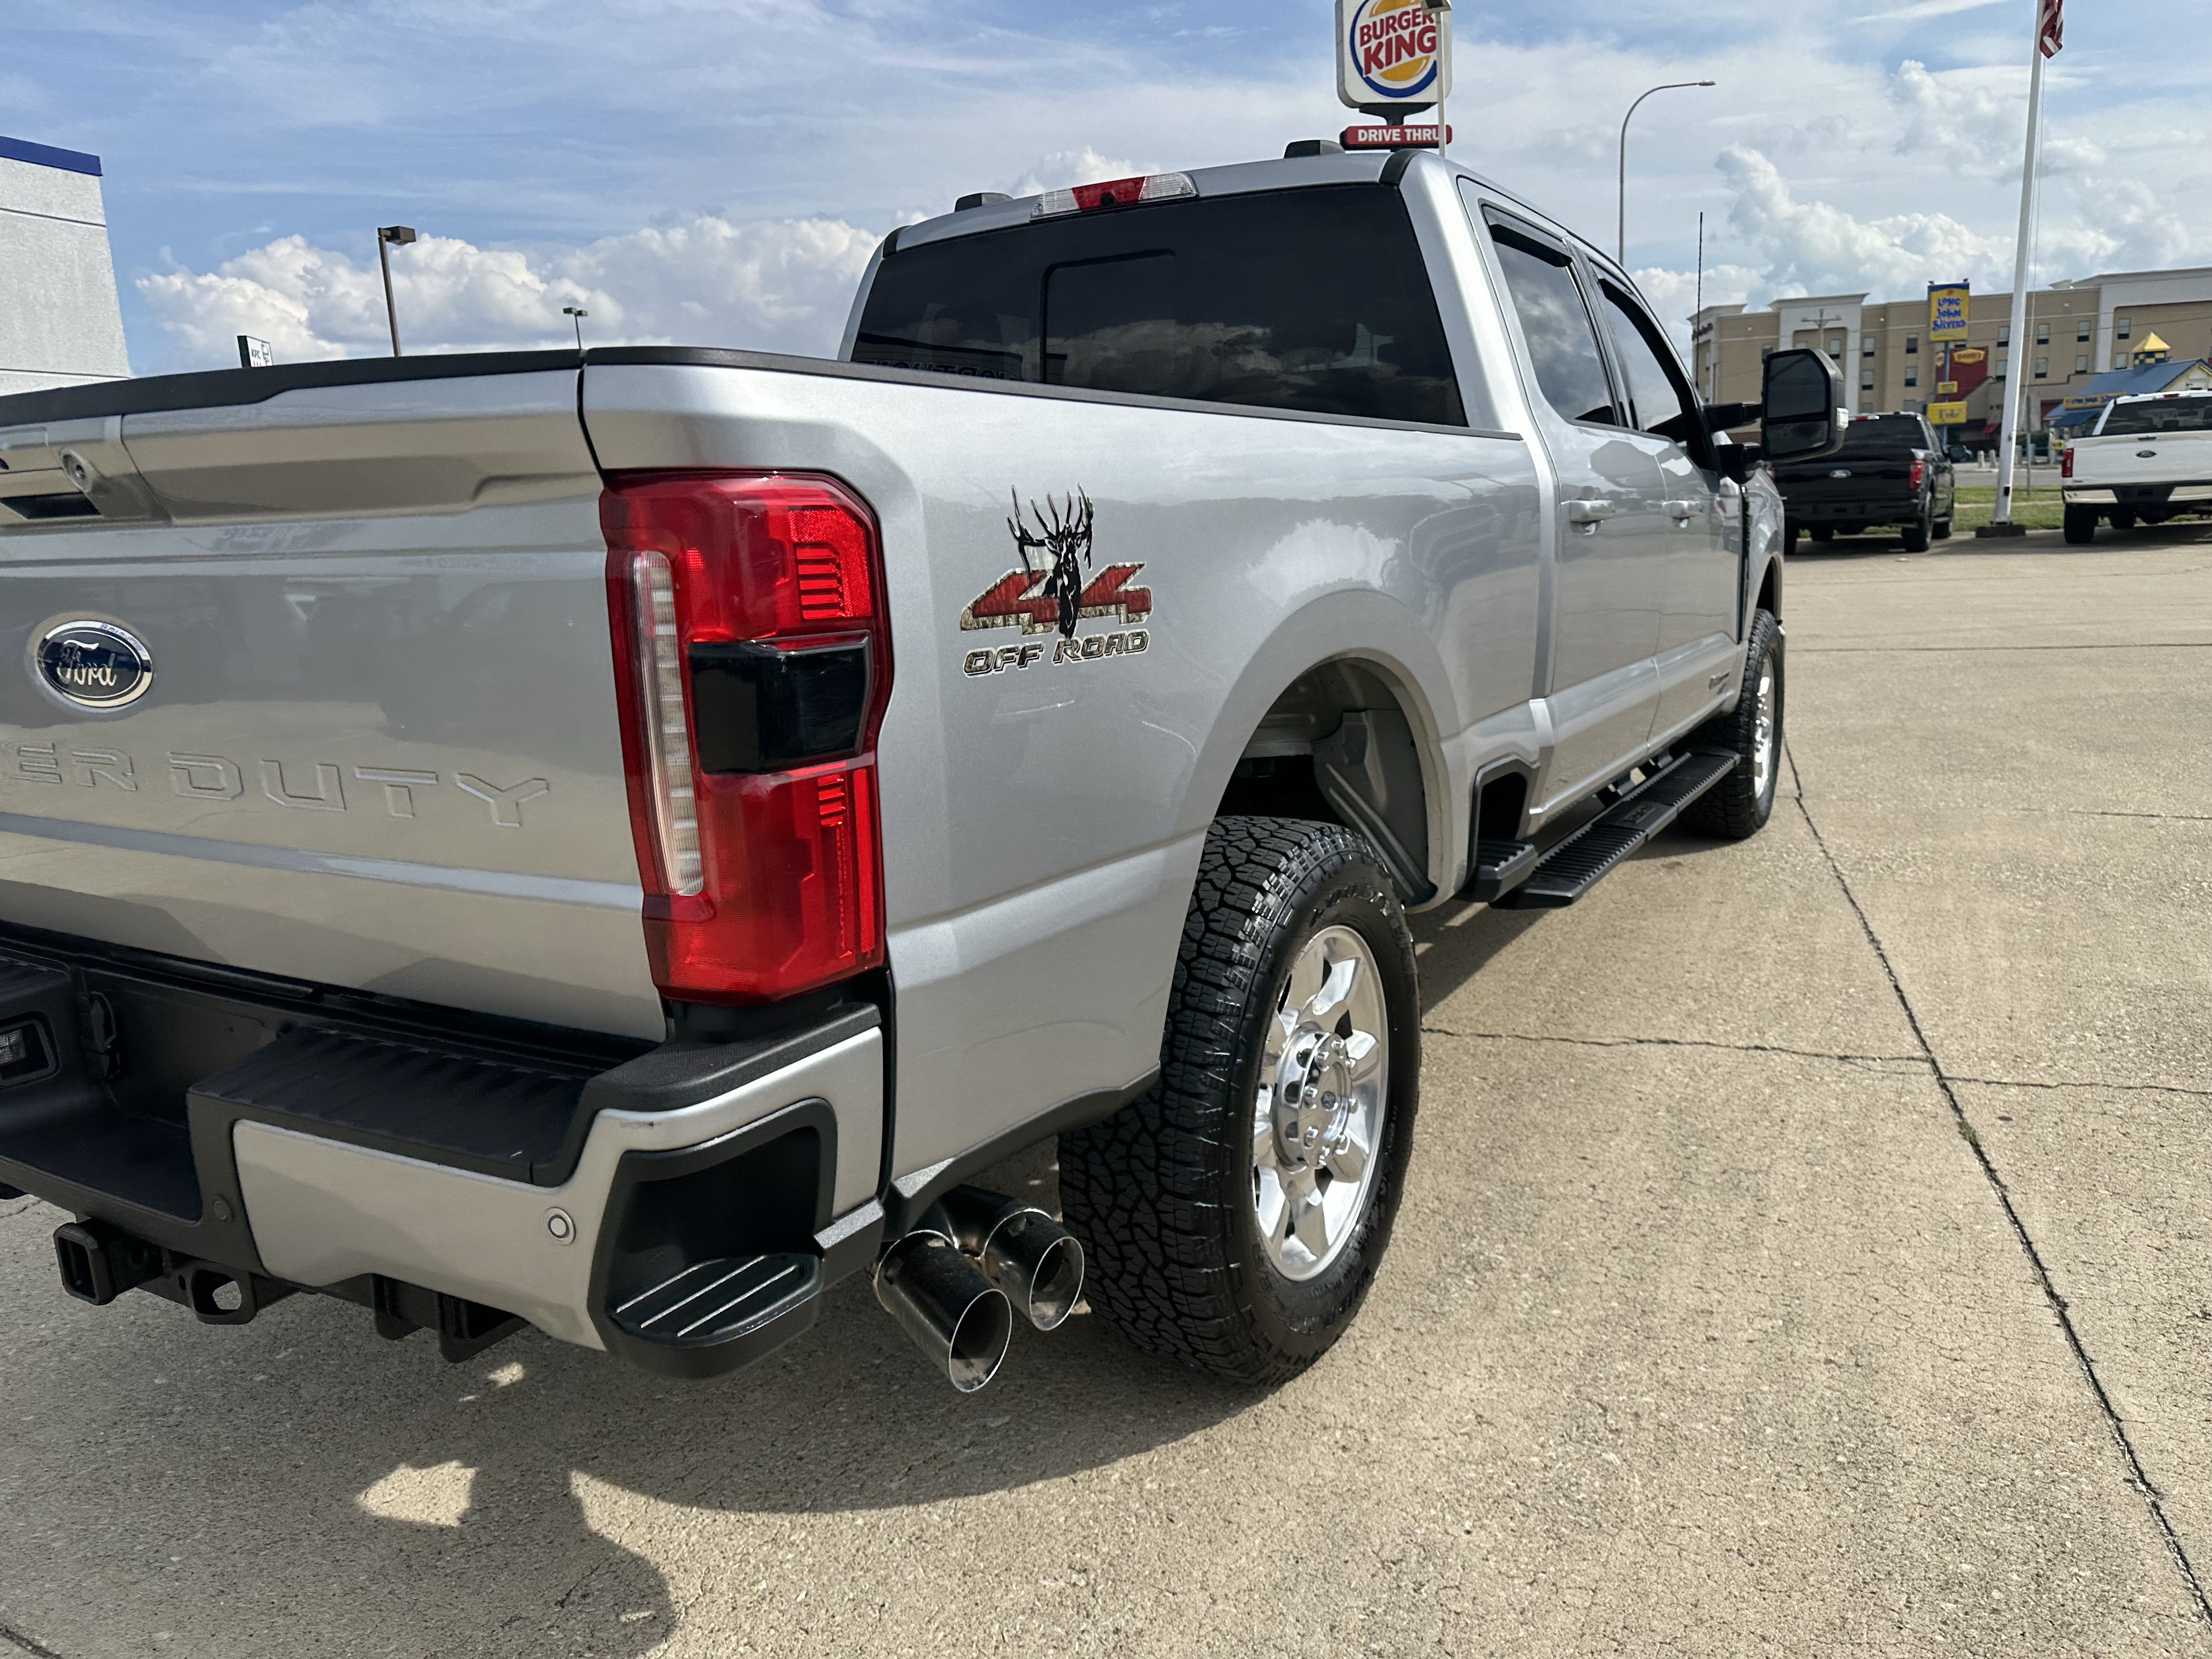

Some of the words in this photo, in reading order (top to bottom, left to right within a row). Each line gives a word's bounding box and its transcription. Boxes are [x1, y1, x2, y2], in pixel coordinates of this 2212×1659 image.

[1359, 8, 1434, 47] BURGER
[1363, 25, 1436, 75] KING
[1358, 129, 1401, 142] DRIVE
[1404, 128, 1440, 141] THRU
[251, 348, 261, 359] KFC
[56, 639, 117, 686] Ford
[963, 641, 1045, 678] OFF
[1052, 630, 1150, 665] ROAD
[166, 752, 549, 827] DUTY
